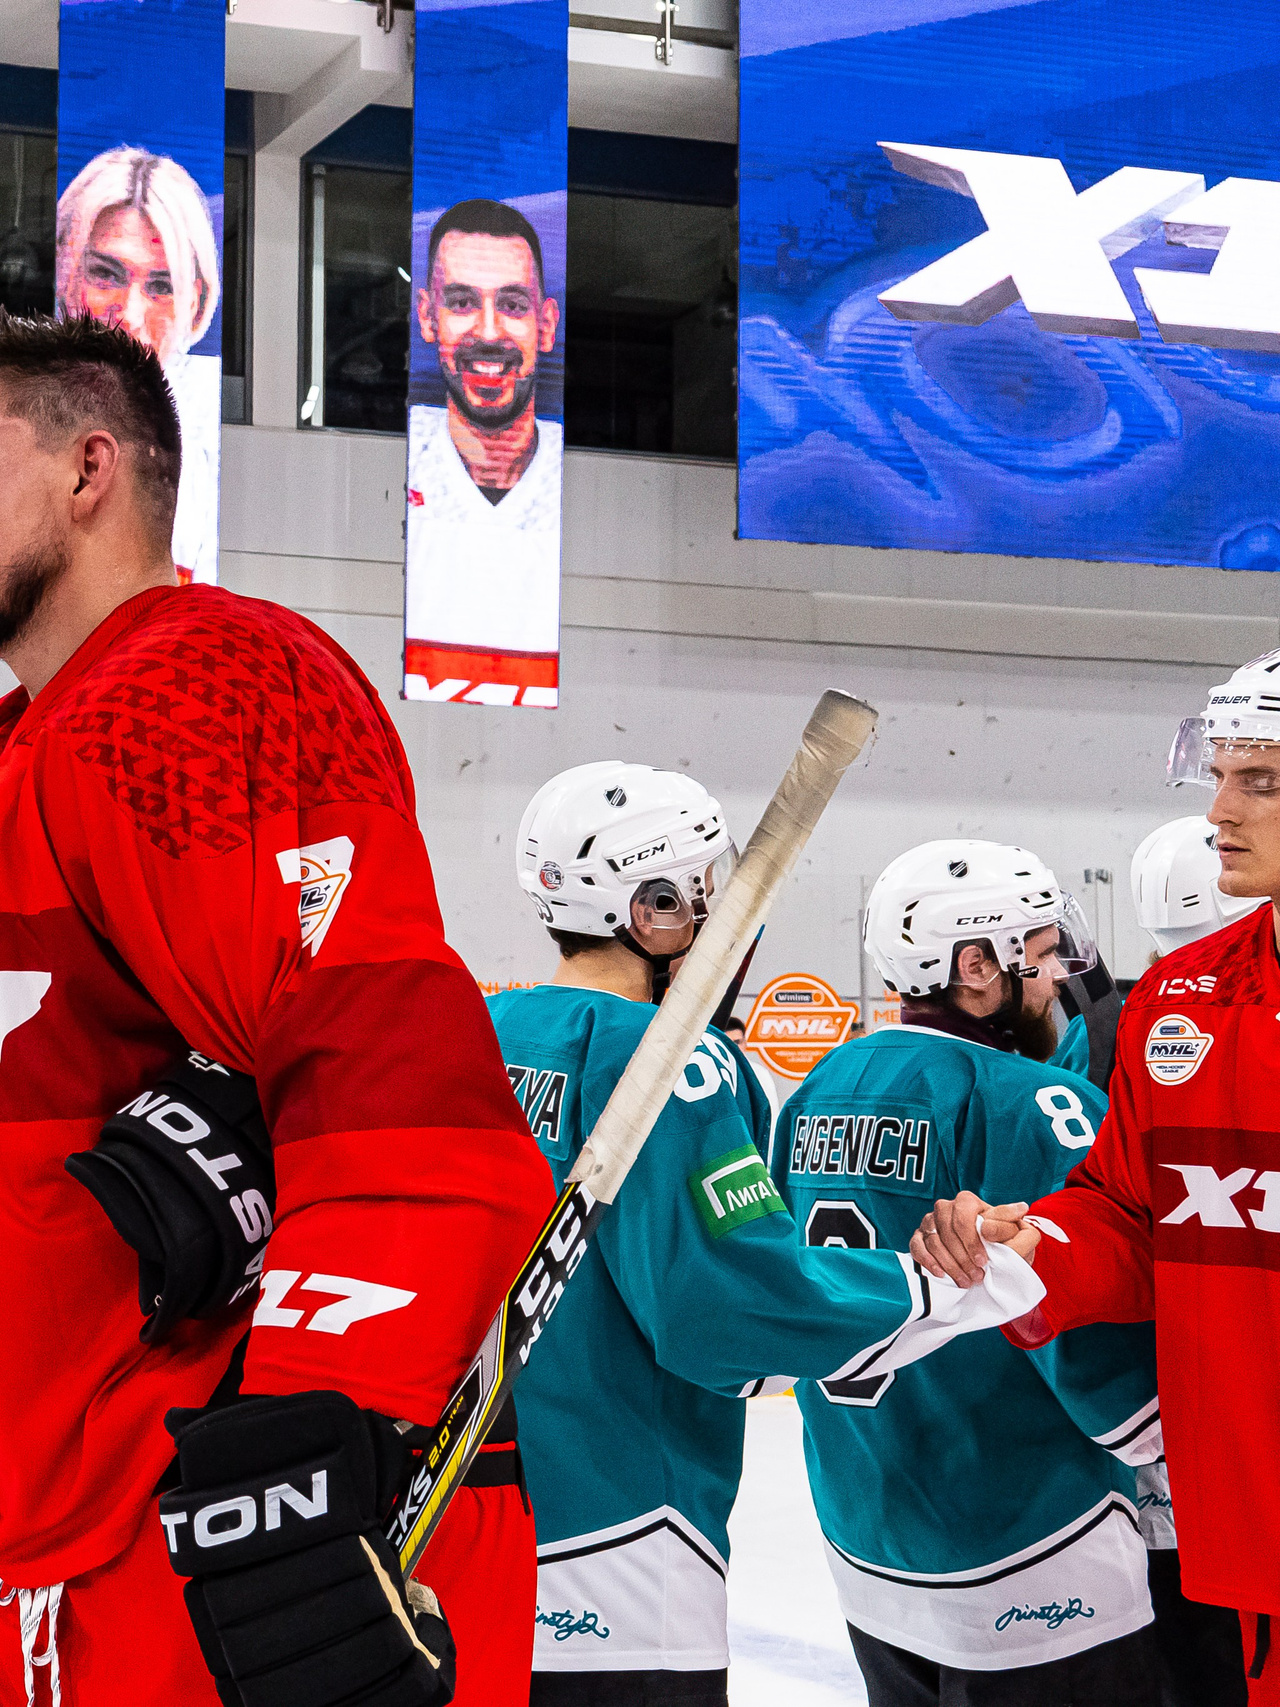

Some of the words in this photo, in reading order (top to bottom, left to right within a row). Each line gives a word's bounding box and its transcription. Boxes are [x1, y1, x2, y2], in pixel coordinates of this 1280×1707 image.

[621, 842, 667, 867] CCM
[956, 914, 1004, 926] CCM
[759, 1016, 838, 1037] MHL
[1149, 1042, 1197, 1057] MHL
[789, 1114, 930, 1183] EVGENICH
[428, 1425, 451, 1469] 2.0
